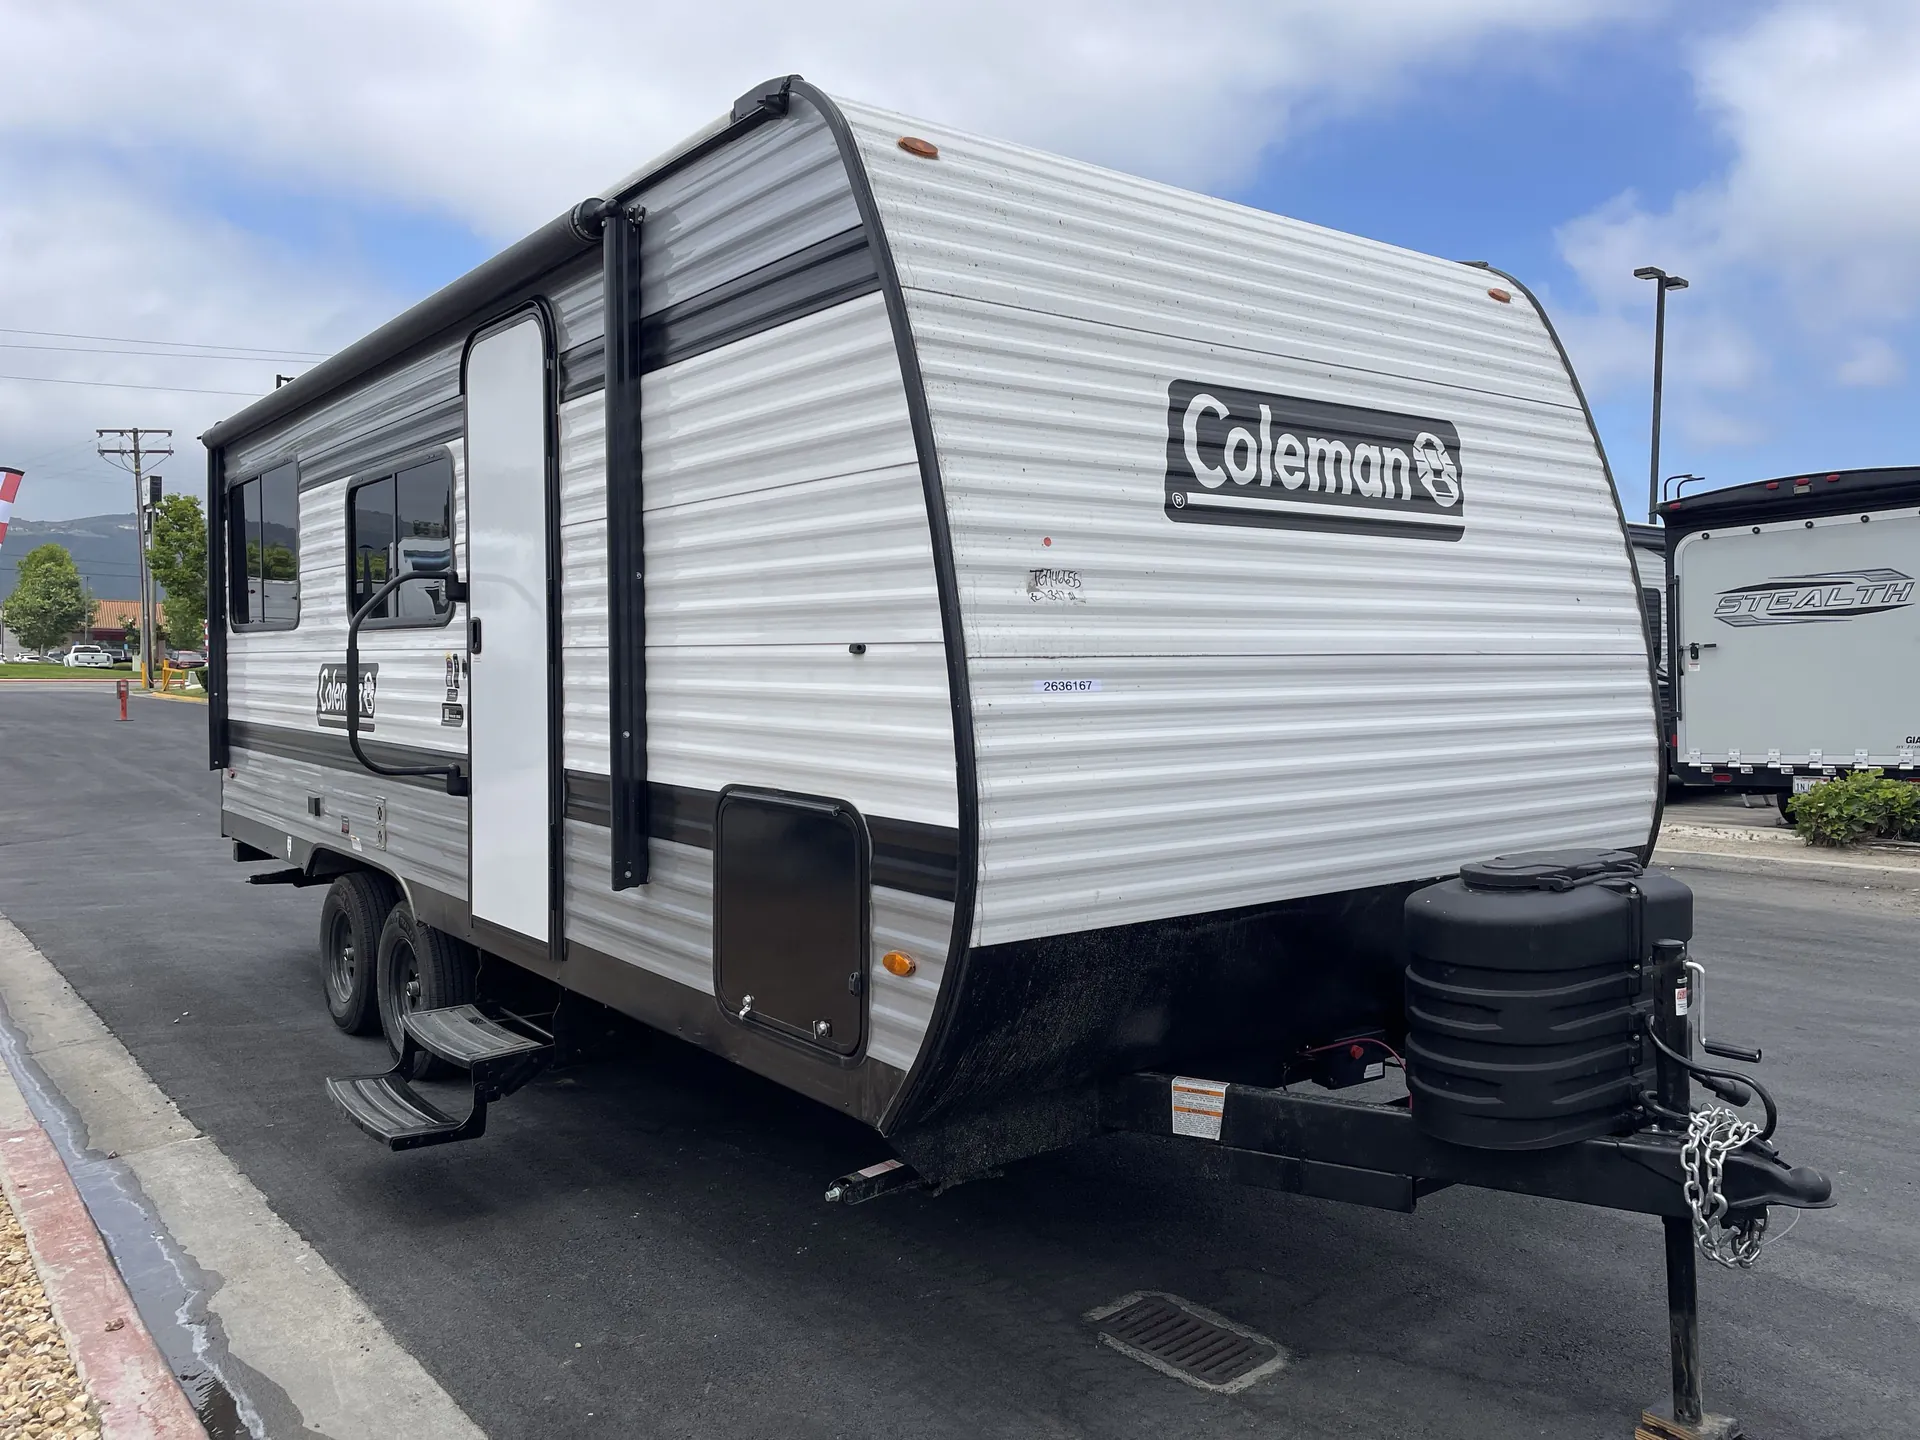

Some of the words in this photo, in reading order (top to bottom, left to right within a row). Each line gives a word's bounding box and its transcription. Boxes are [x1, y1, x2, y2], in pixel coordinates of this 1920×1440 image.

[1183, 393, 1412, 501] Coleman
[1714, 581, 1916, 615] STEALTH
[1043, 680, 1092, 691] 2636167
